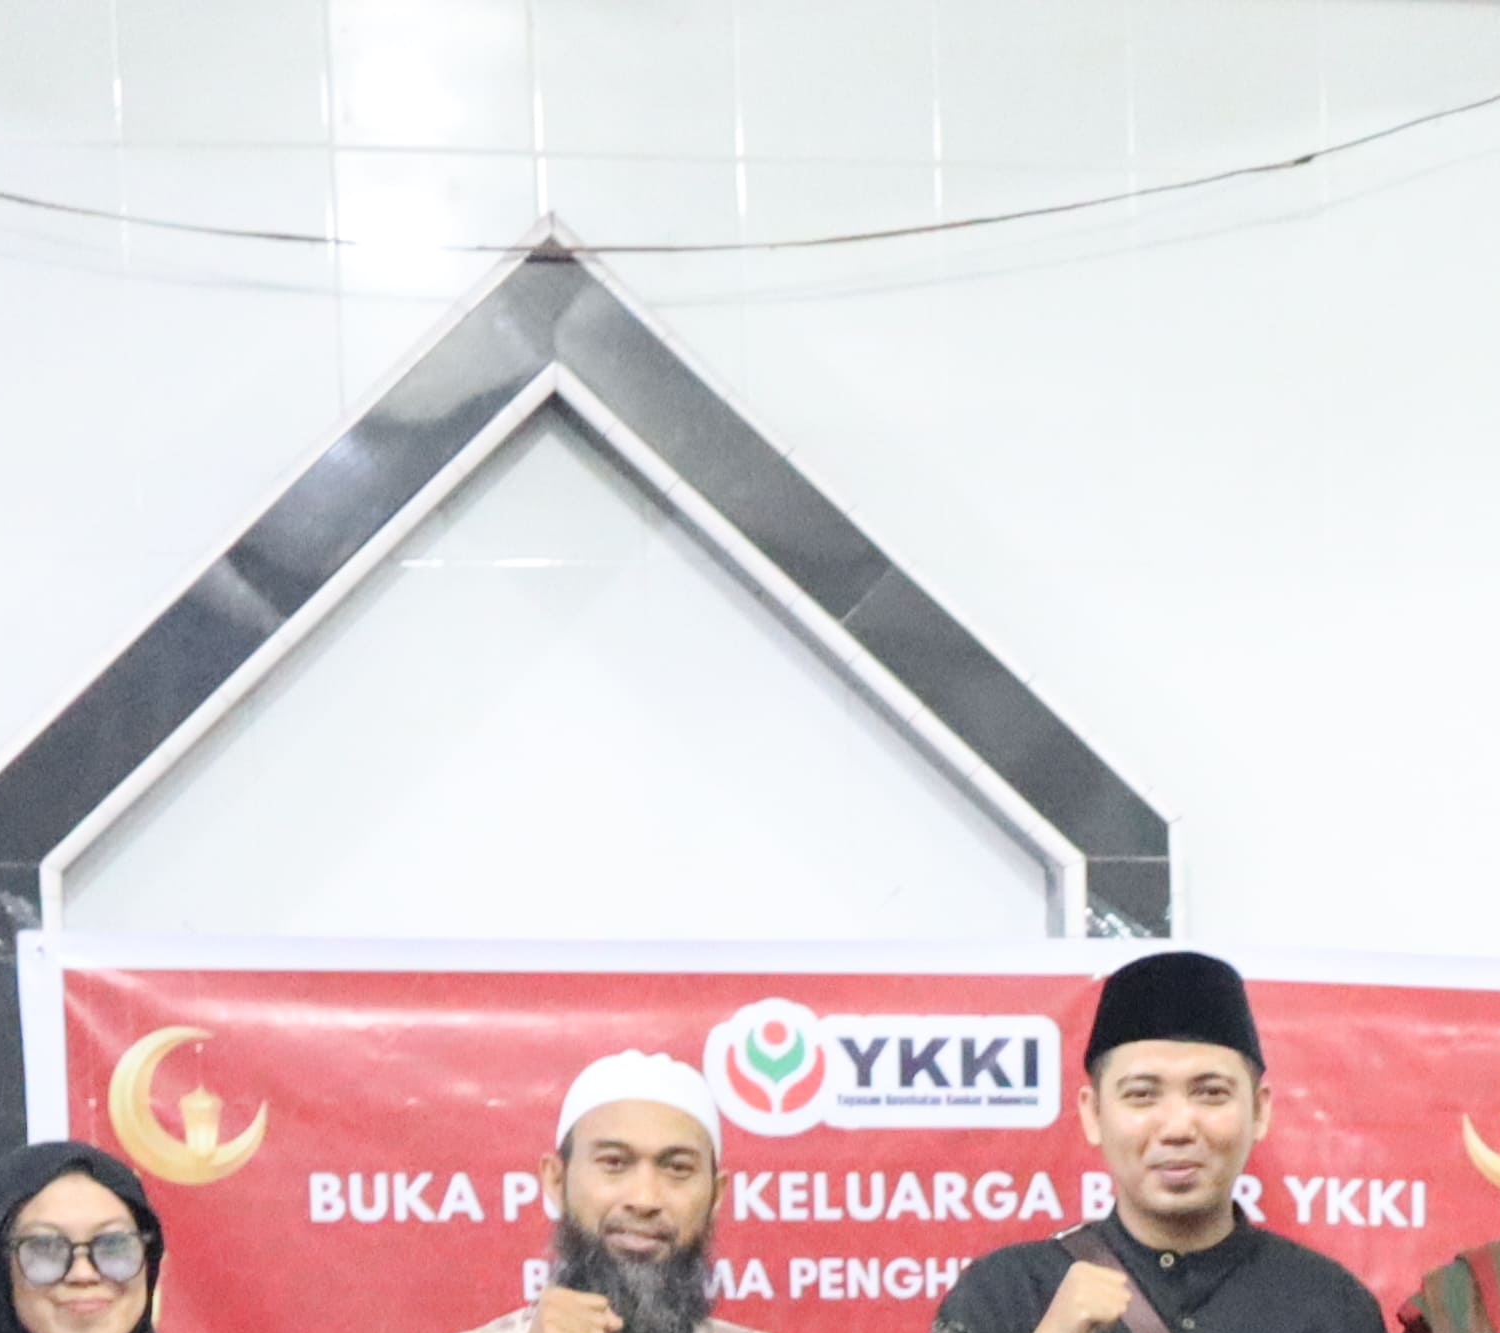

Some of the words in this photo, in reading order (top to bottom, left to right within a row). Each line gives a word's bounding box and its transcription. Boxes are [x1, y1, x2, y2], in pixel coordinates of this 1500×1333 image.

[837, 1036, 1039, 1088] YKKI
[308, 1171, 485, 1223] BUKA
[732, 1171, 1064, 1222] KELUARGA
[1282, 1175, 1427, 1228] YKKI
